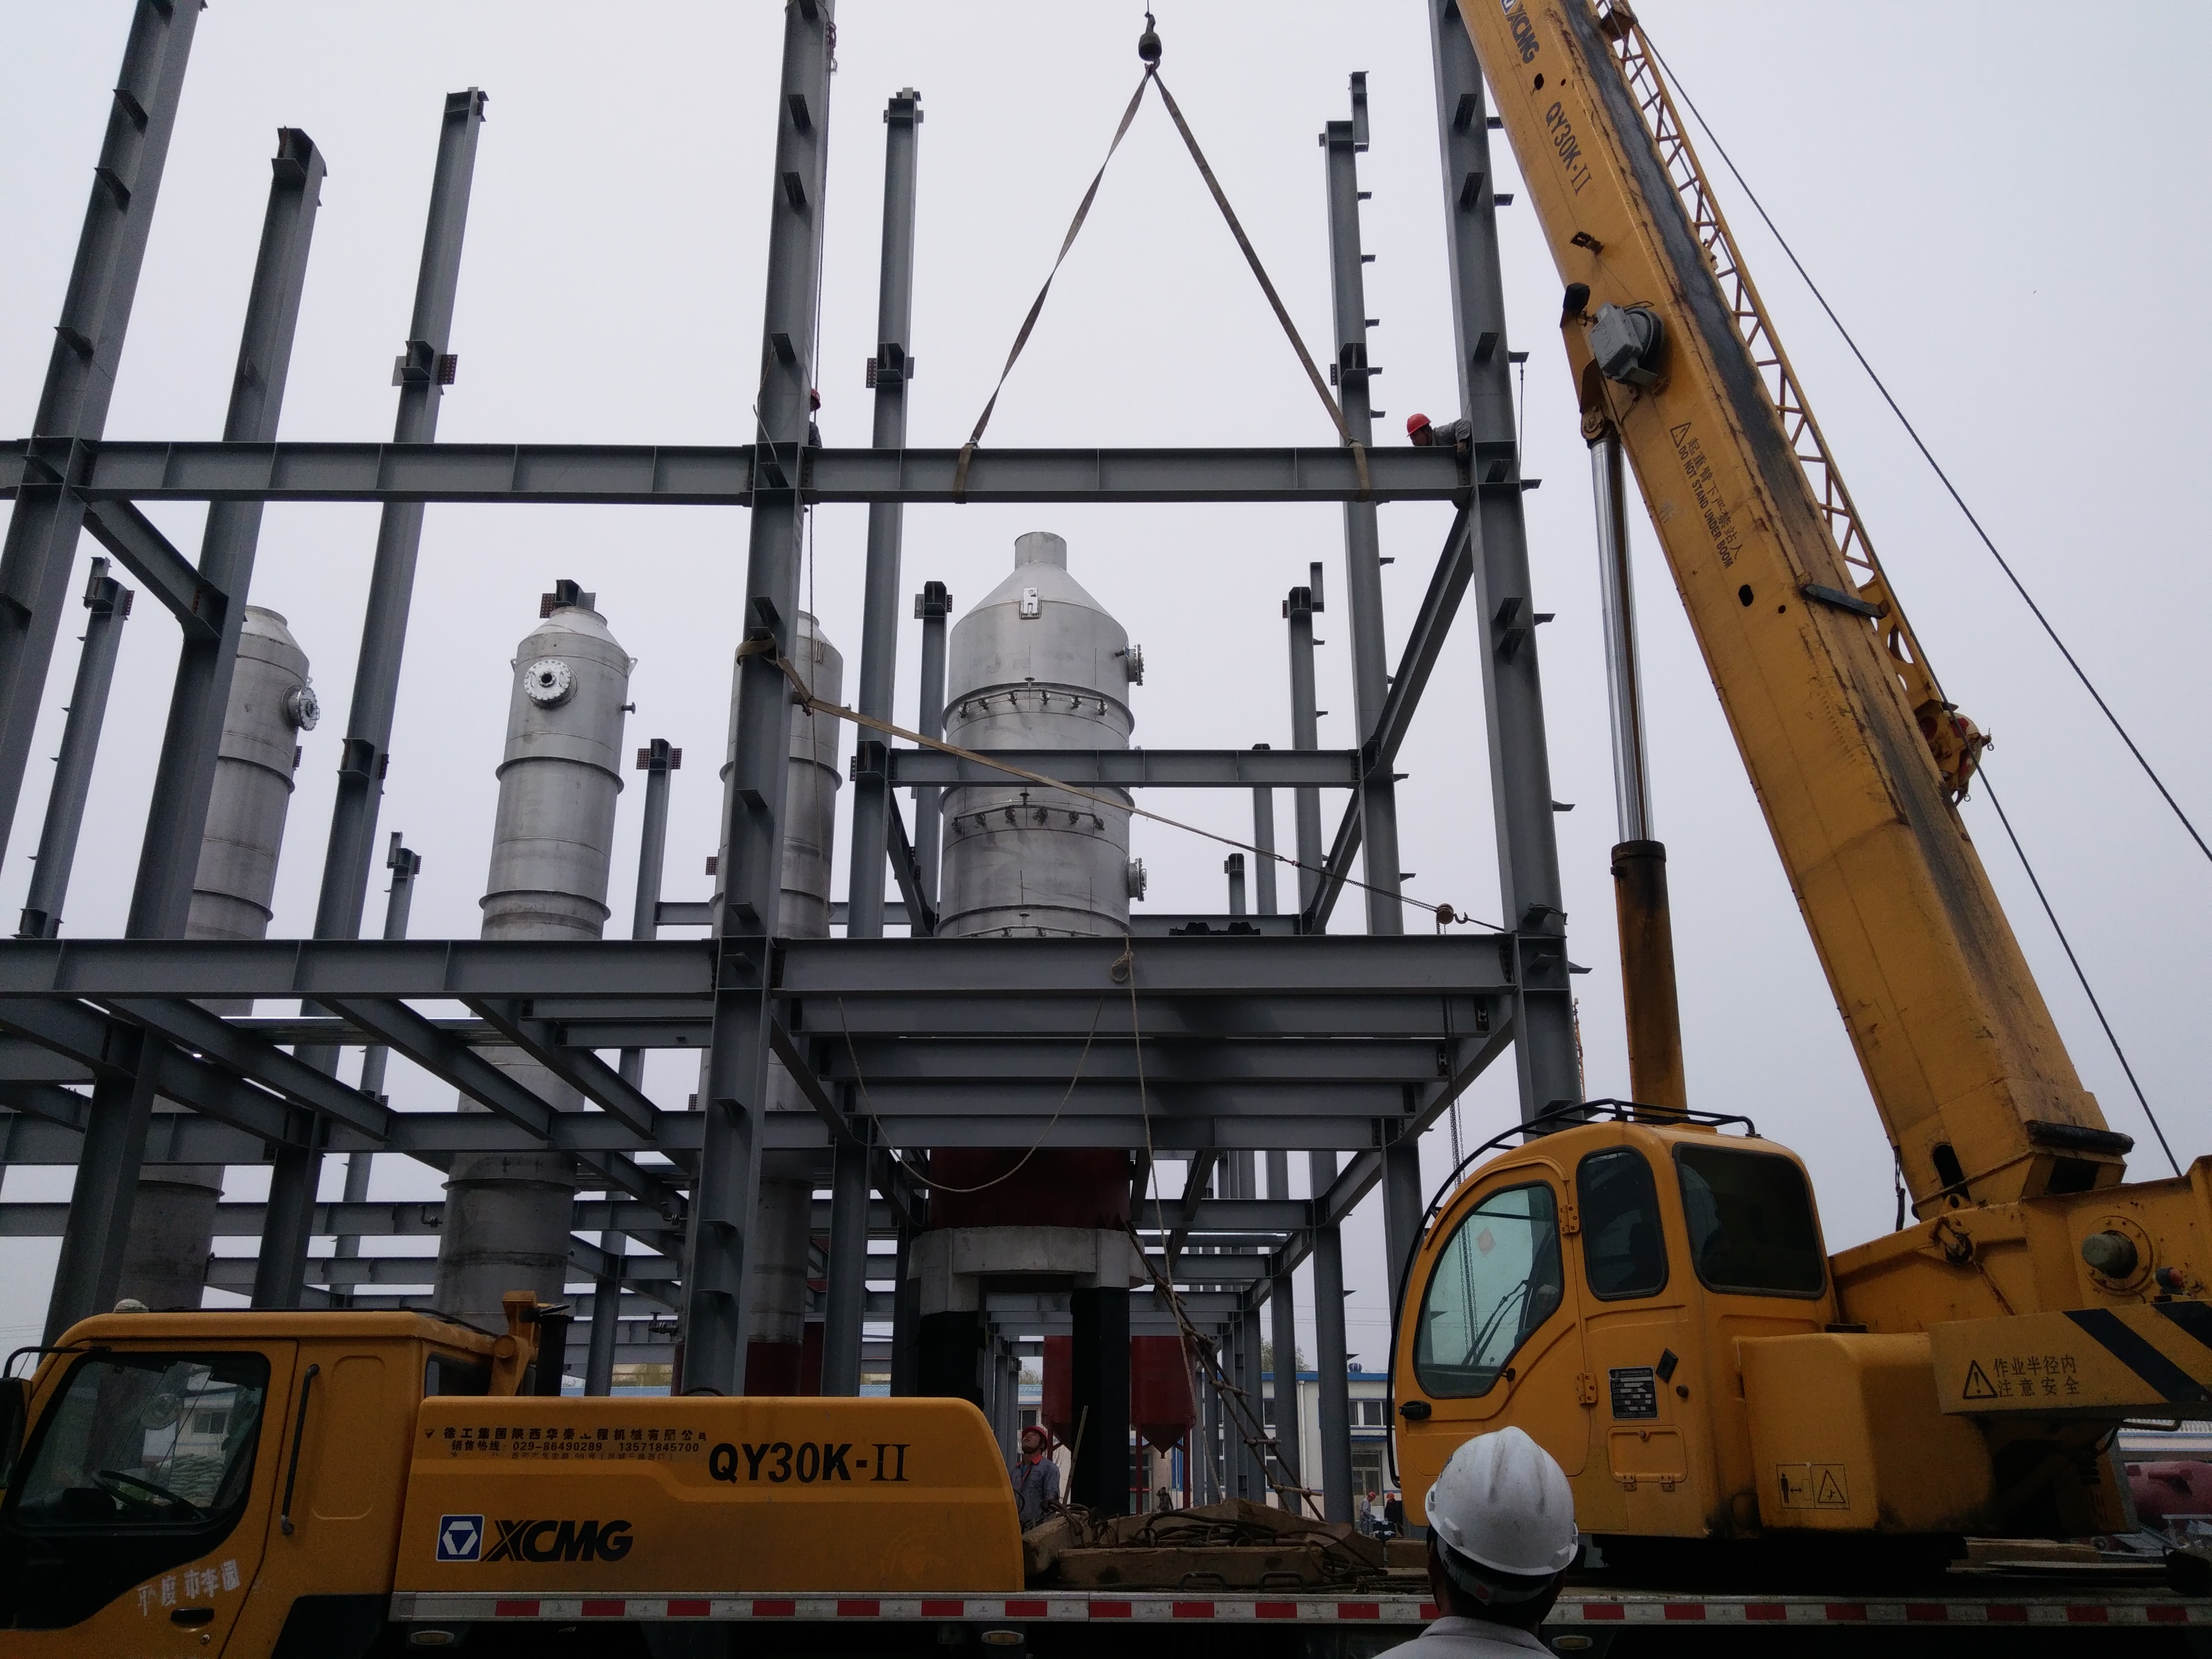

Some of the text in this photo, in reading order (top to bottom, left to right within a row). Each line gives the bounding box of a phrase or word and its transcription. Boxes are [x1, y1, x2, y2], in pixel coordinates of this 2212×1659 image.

[1506, 3, 1539, 64] XCMG
[1678, 446, 1734, 569] DO NOT STAND UNDER BOOM
[1687, 437, 1743, 560] 起重臂下严禁站人
[1994, 1354, 2076, 1378] 作业半径内
[1997, 1376, 2080, 1398] 注意安全
[513, 1442, 602, 1451] 029-86490289
[619, 1442, 699, 1452] 13571845700
[481, 1519, 633, 1562] XCMG
